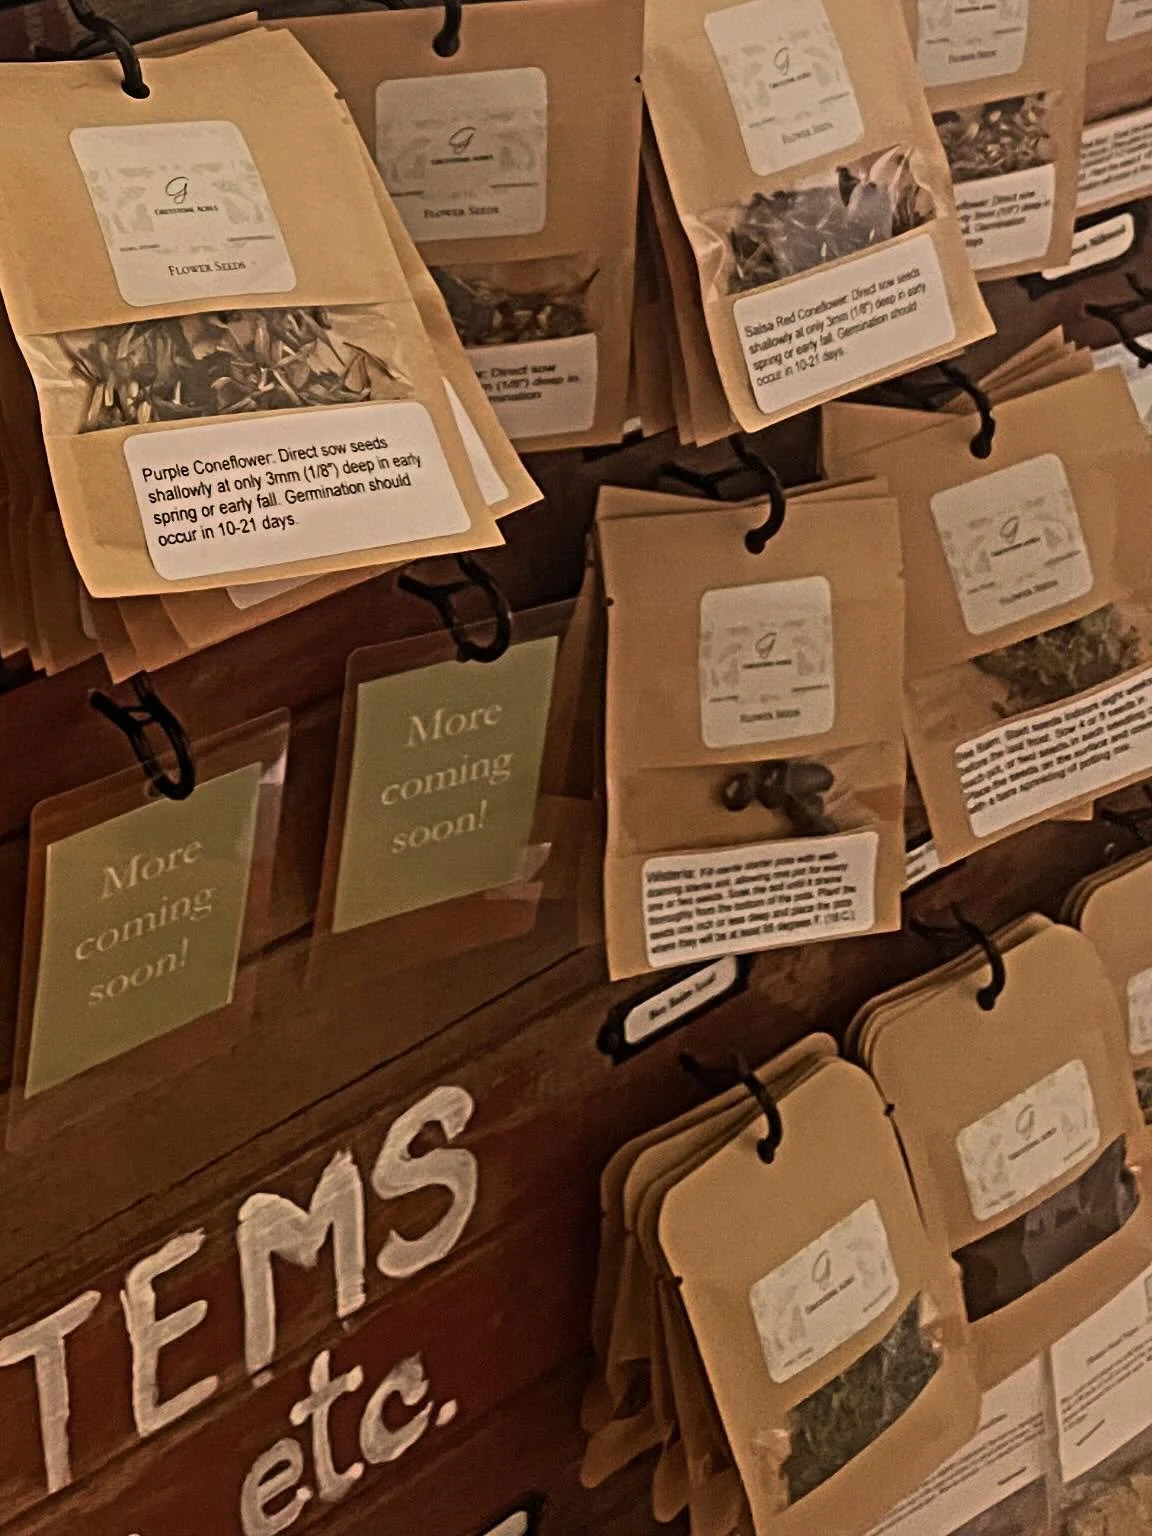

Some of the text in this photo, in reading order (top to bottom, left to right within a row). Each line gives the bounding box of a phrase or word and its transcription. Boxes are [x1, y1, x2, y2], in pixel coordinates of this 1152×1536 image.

[141, 463, 189, 482] Purple
[276, 445, 319, 462] Direct
[319, 443, 346, 457] sow
[349, 436, 388, 453] seeds
[404, 700, 503, 750] More
[379, 752, 513, 806] coming
[391, 800, 489, 855] soon!
[100, 838, 204, 900] More
[74, 887, 217, 961] coming
[87, 938, 190, 1006] soon!
[240, 1348, 458, 1536] etc.
